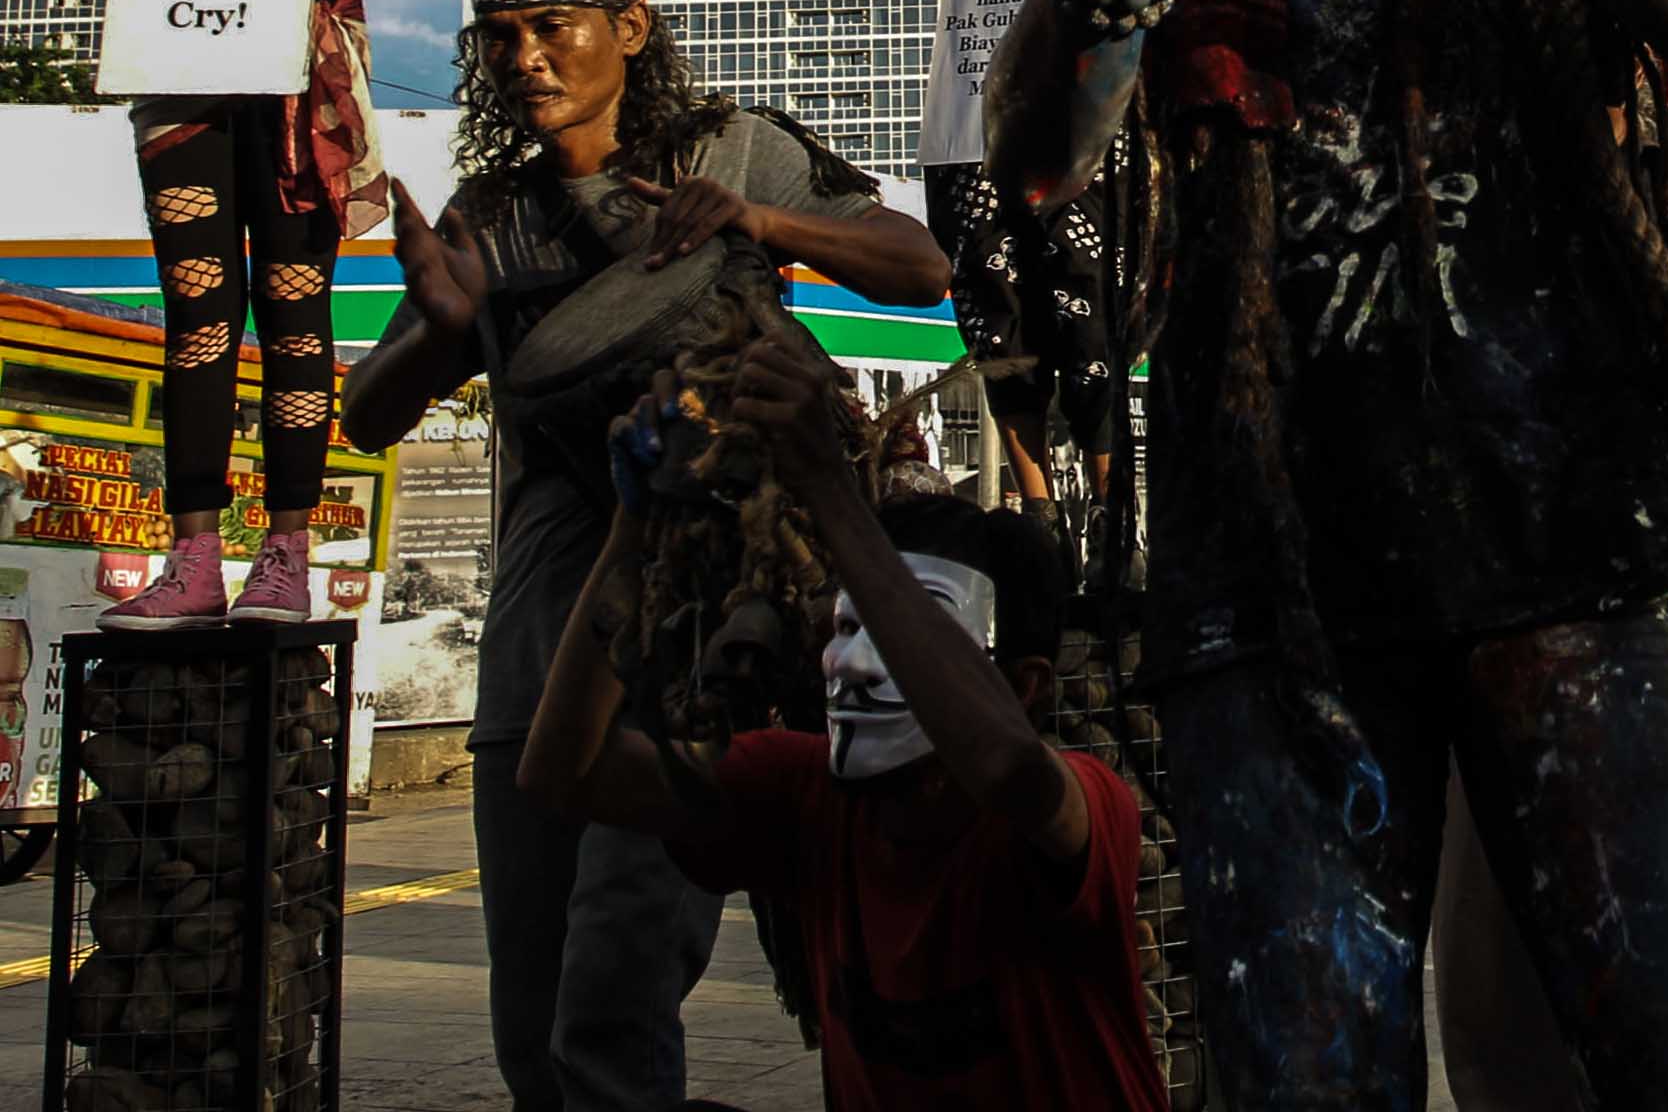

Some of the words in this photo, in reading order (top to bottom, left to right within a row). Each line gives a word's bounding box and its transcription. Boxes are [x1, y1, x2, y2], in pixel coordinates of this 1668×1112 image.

[168, 1, 247, 35] Cry!
[945, 13, 978, 31] Pak
[23, 470, 96, 506] NASI
[103, 570, 143, 589] NEW
[333, 579, 367, 599] NEW
